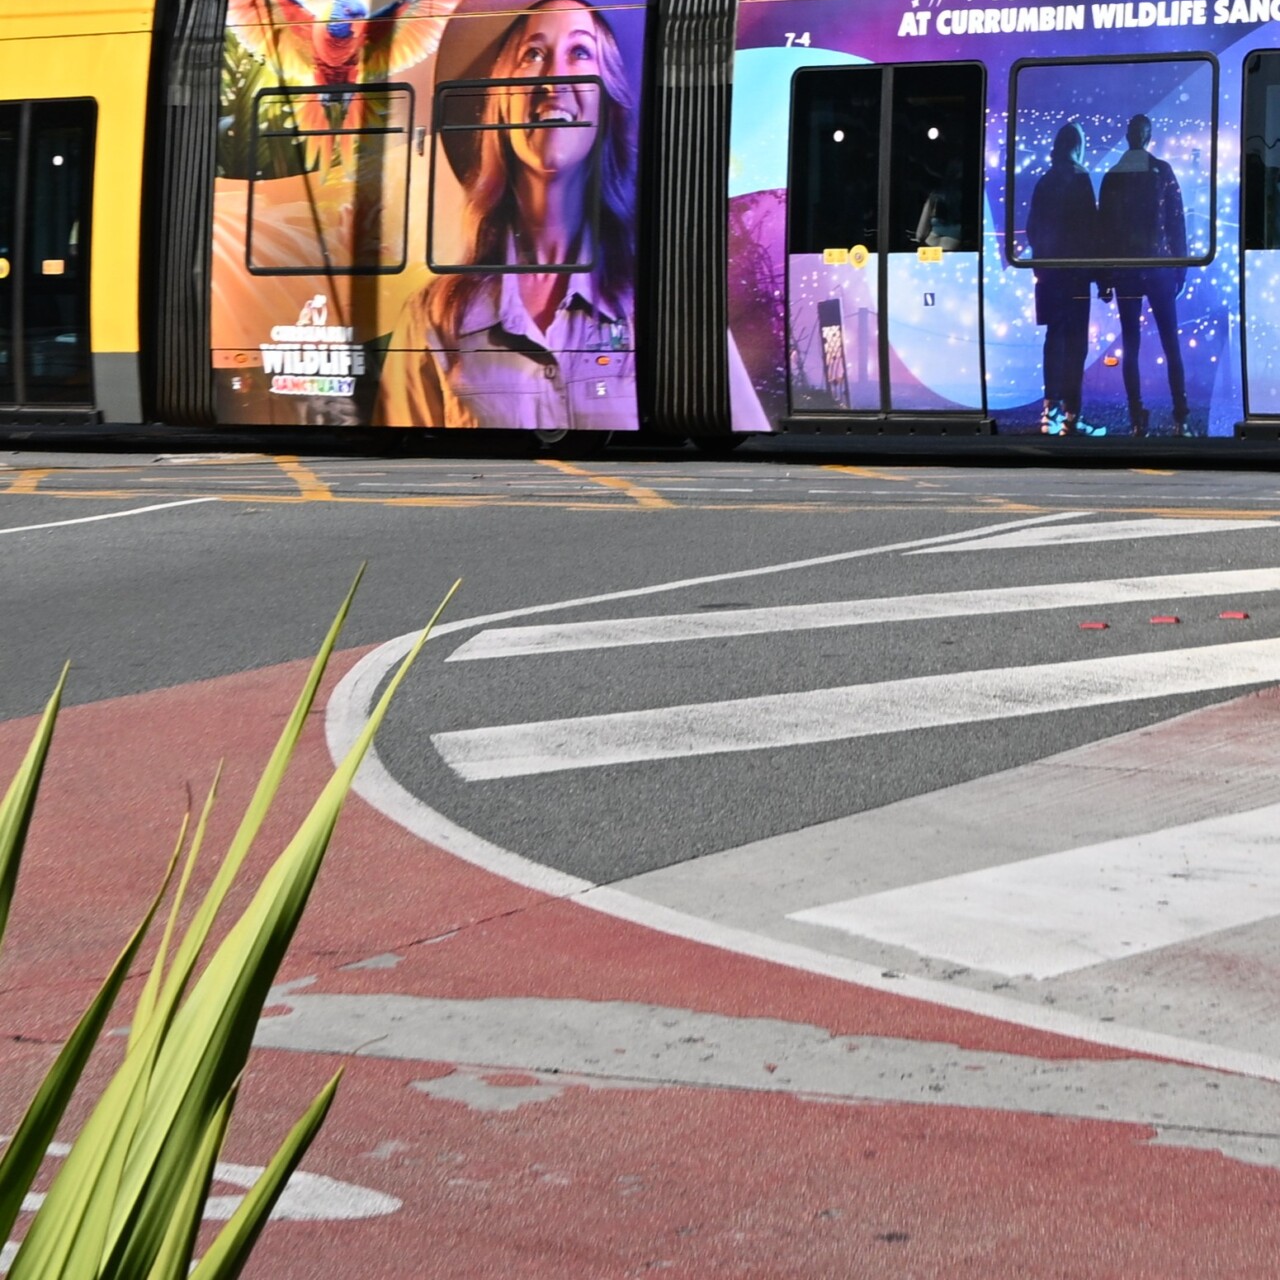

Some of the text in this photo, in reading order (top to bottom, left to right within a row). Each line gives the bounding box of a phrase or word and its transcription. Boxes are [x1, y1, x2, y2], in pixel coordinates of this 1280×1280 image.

[898, 11, 931, 36] AT
[936, 4, 1085, 35] CURRUMBIN
[1092, 0, 1208, 29] WILDLIFE
[784, 31, 811, 48] 7-4
[259, 343, 366, 376] WILDLIFE
